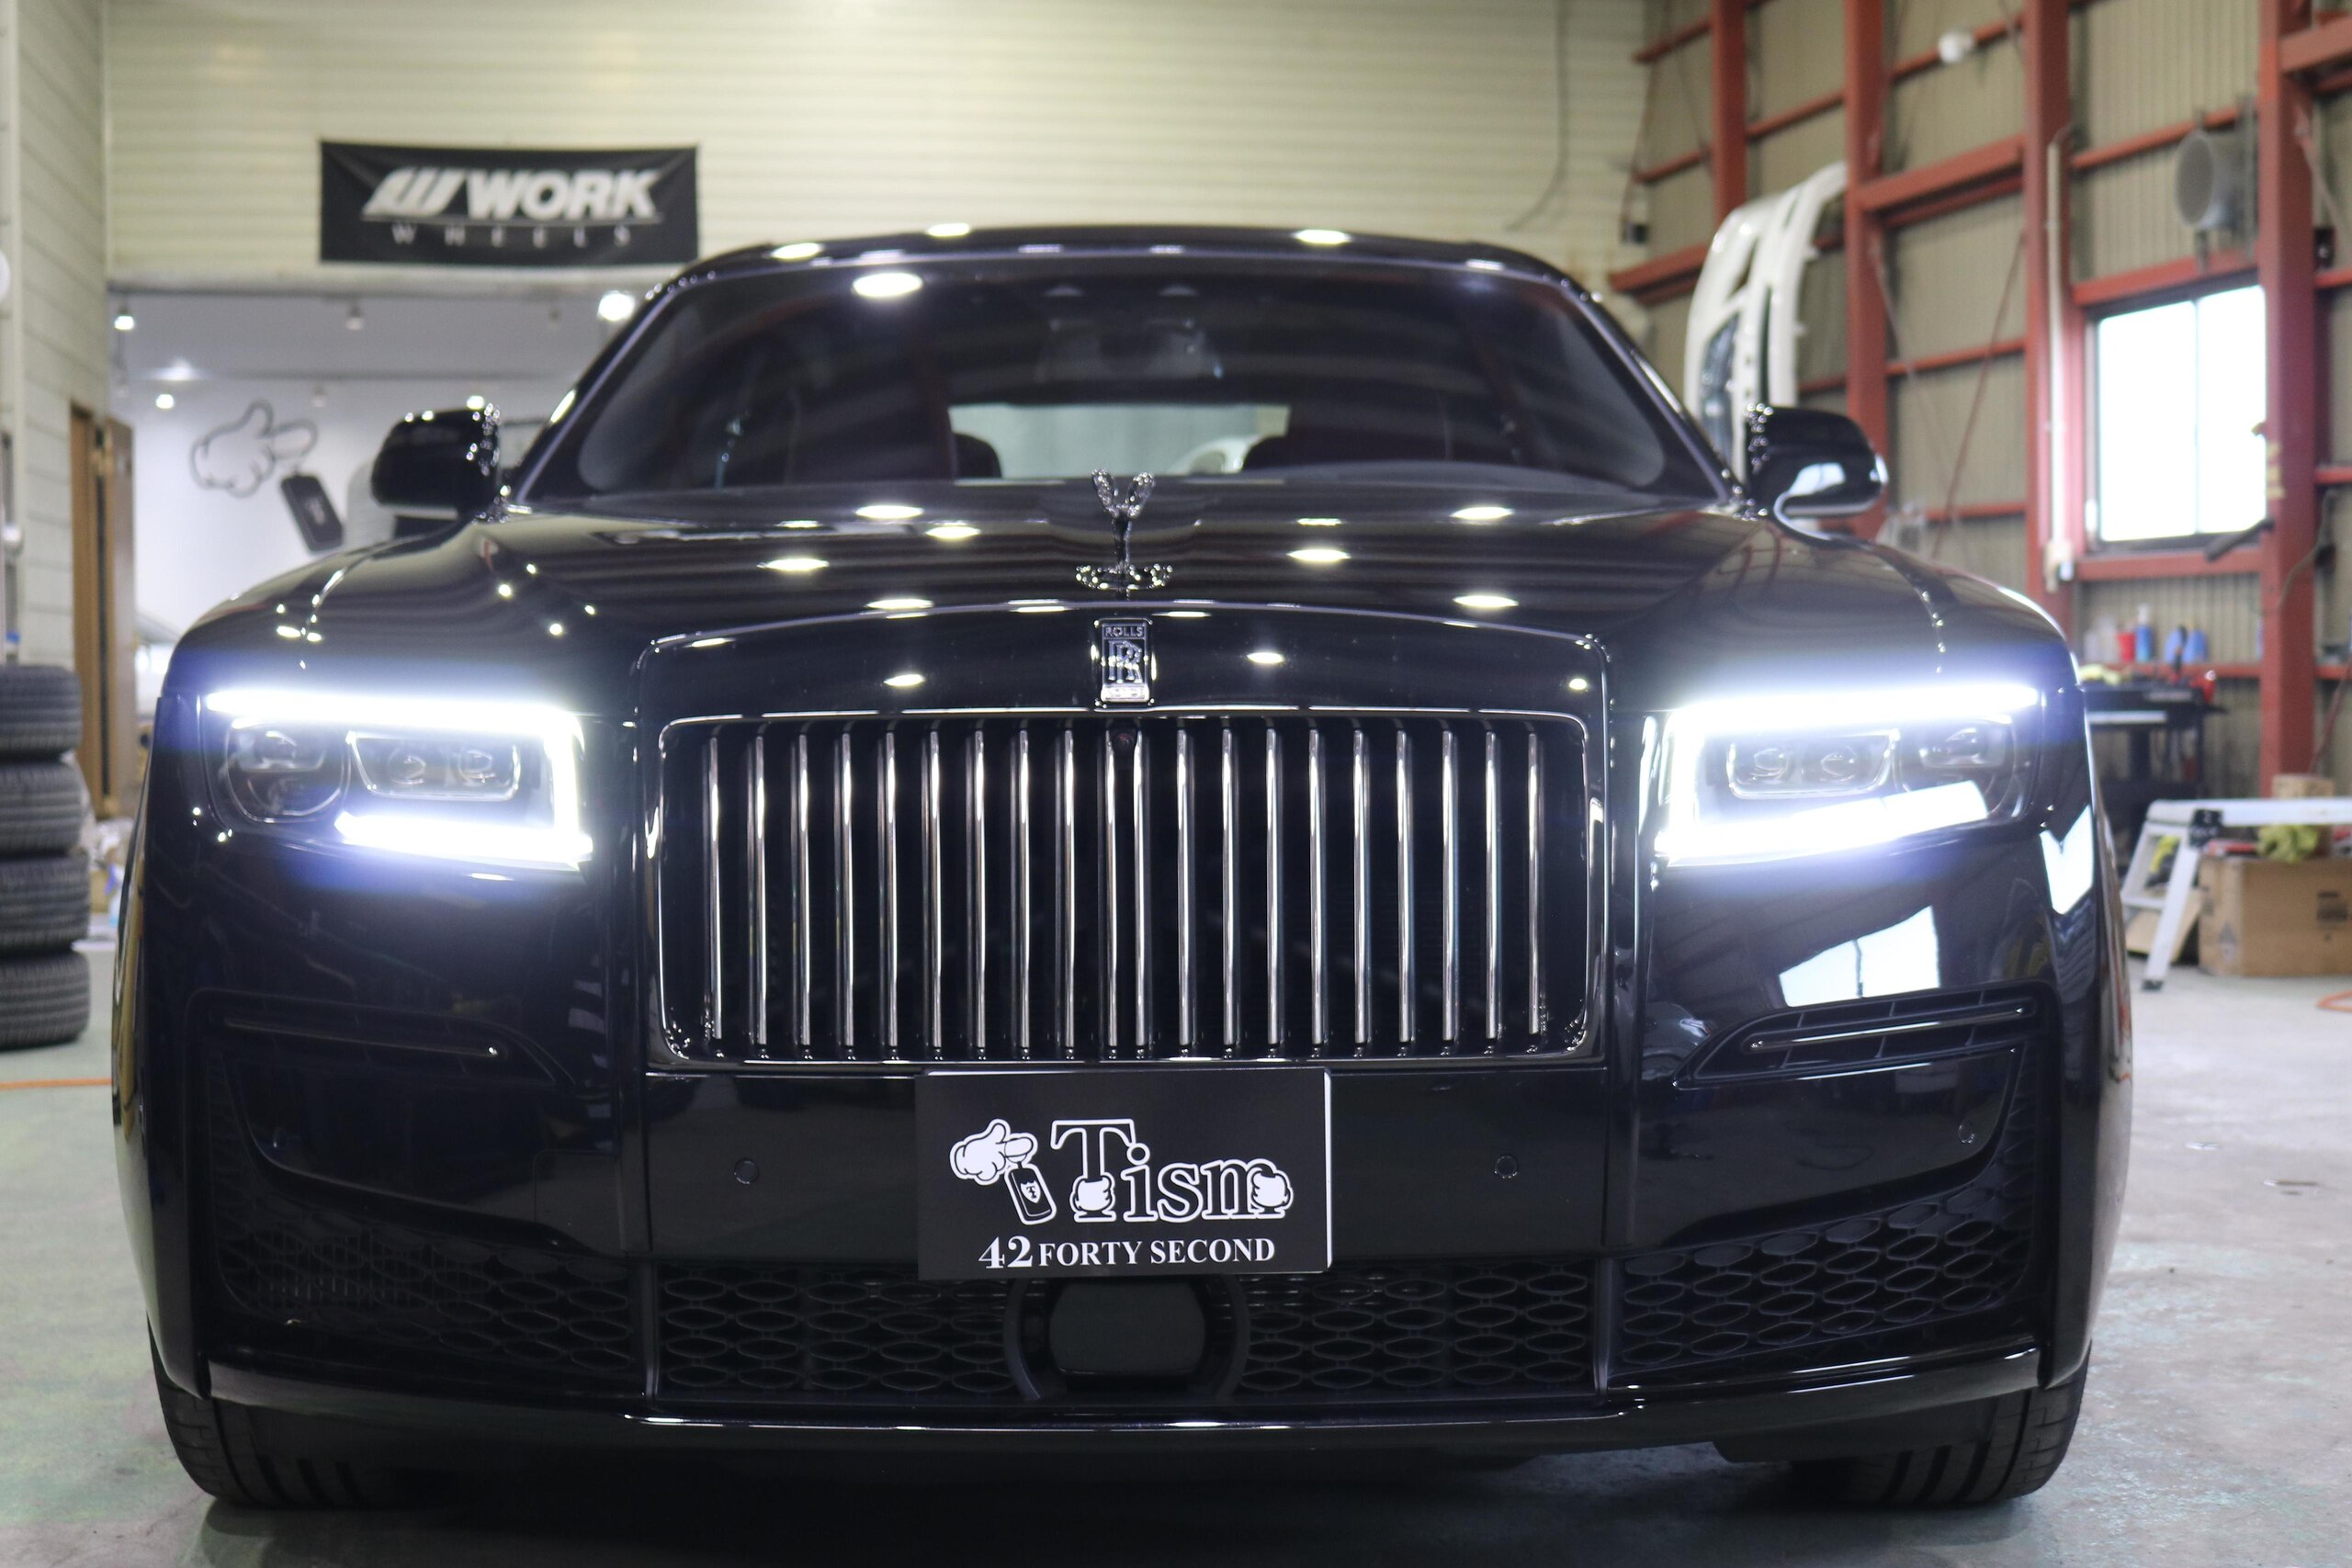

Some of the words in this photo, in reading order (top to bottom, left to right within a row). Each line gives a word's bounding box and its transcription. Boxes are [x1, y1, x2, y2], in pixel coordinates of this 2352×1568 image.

[467, 168, 662, 220] WORK
[1105, 626, 1143, 637] ROLLS
[1050, 1119, 1294, 1224] Tism
[978, 1235, 1033, 1269] 42
[1039, 1240, 1143, 1267] FORTY
[1150, 1237, 1275, 1265] SECOND
